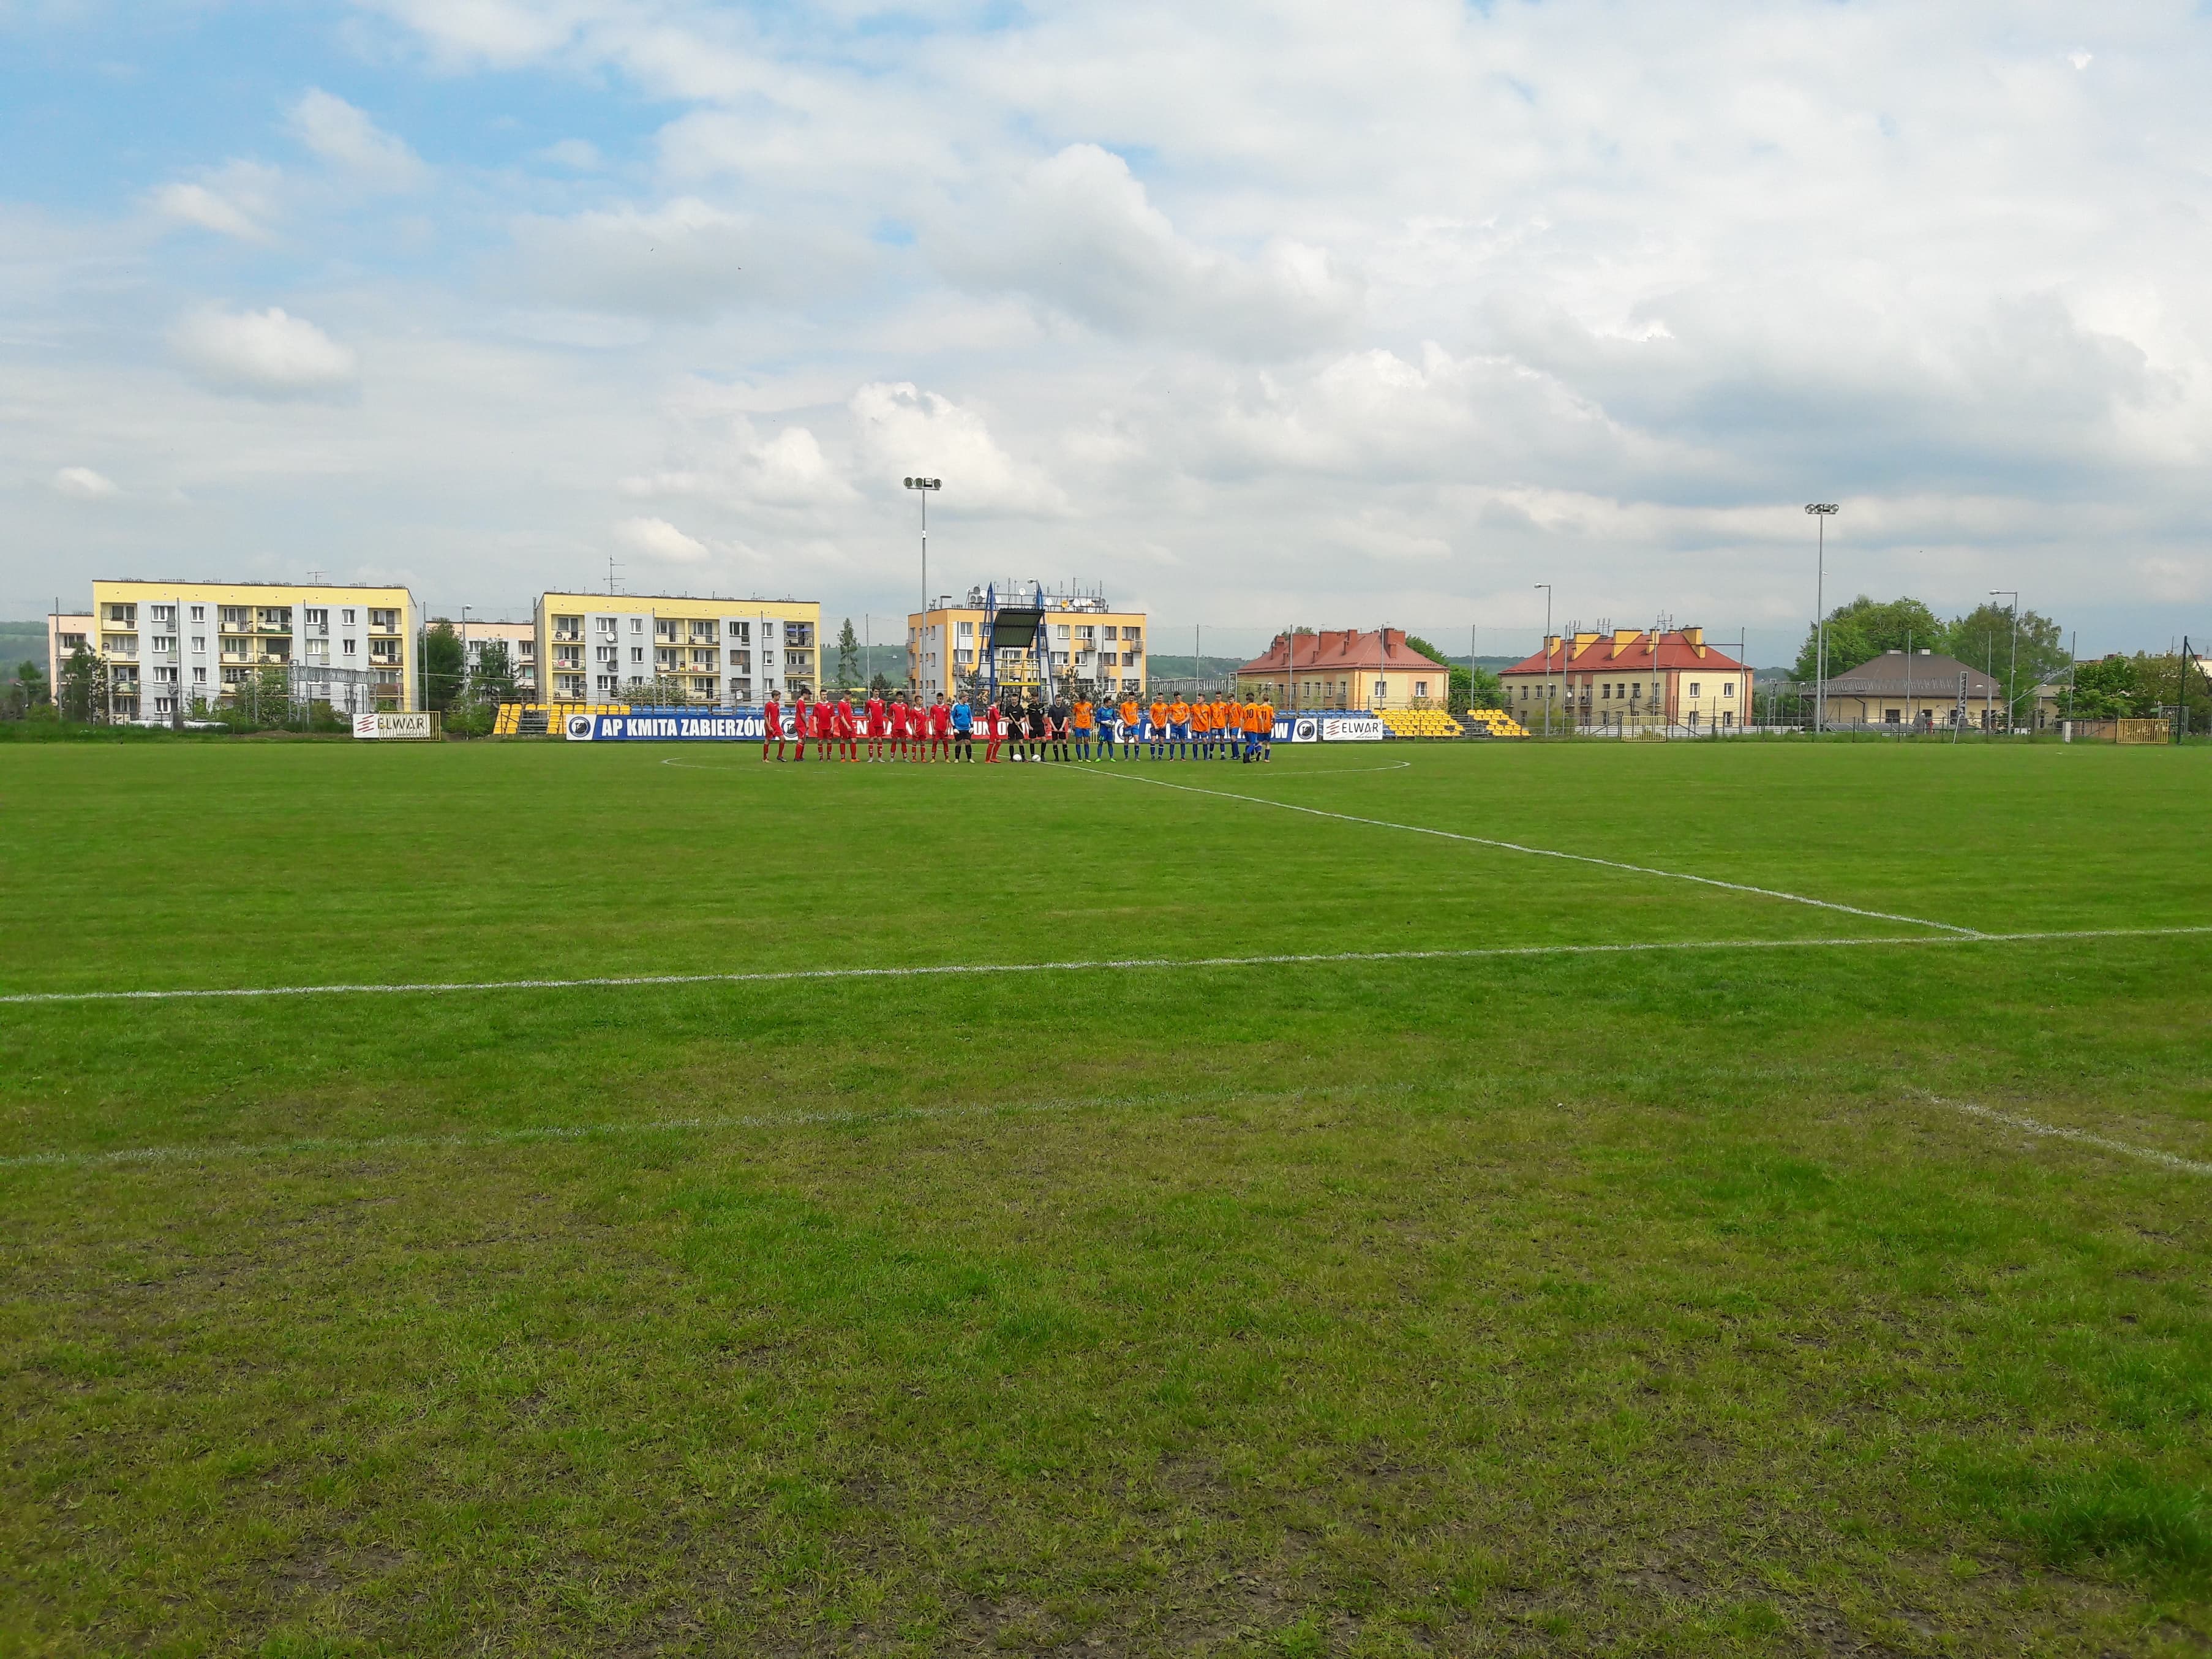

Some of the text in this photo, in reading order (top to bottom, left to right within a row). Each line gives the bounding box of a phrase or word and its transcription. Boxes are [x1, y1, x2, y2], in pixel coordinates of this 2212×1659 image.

[1246, 709, 1254, 718] 10
[378, 718, 425, 729] ELWAR
[601, 719, 623, 736] AP
[626, 719, 678, 736] KMITA
[680, 717, 766, 737] ZABIERZÓW
[1342, 723, 1379, 733] ELWAR
